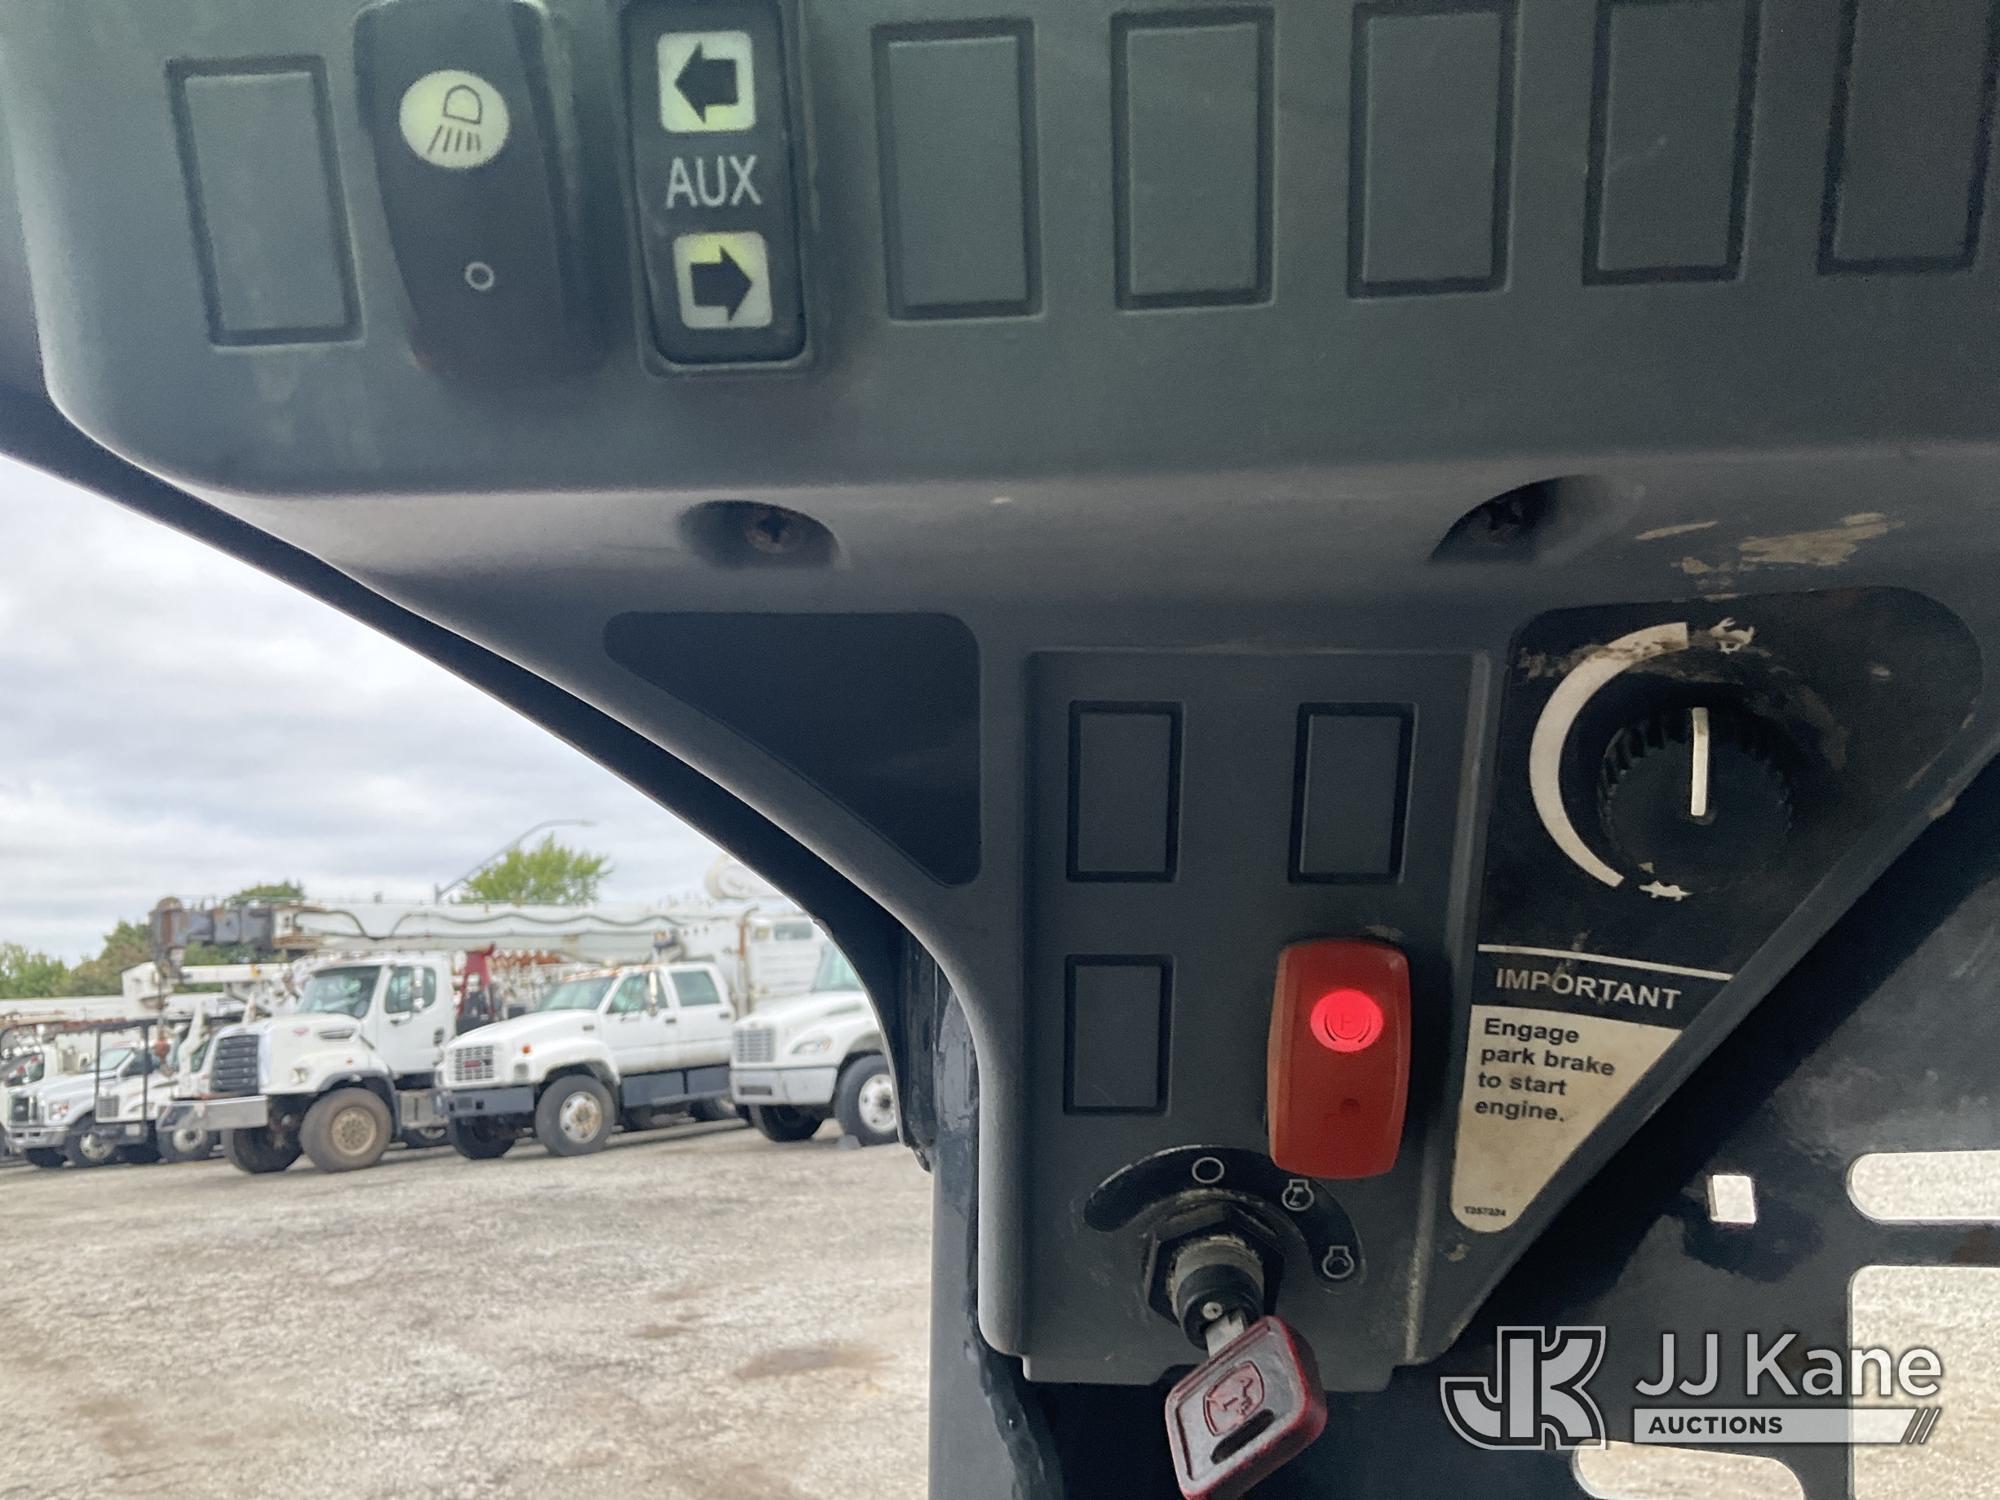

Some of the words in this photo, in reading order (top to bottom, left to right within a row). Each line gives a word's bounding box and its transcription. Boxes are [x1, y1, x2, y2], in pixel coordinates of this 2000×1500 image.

[665, 154, 762, 209] AUX
[1495, 967, 1682, 1010] IMPORTANT
[1484, 1017, 1580, 1045] Engage
[1480, 1047, 1535, 1066] park
[1544, 1050, 1616, 1076] brake
[1478, 1072, 1502, 1089] to
[1510, 1074, 1567, 1096] start
[1475, 1100, 1565, 1122] engine.
